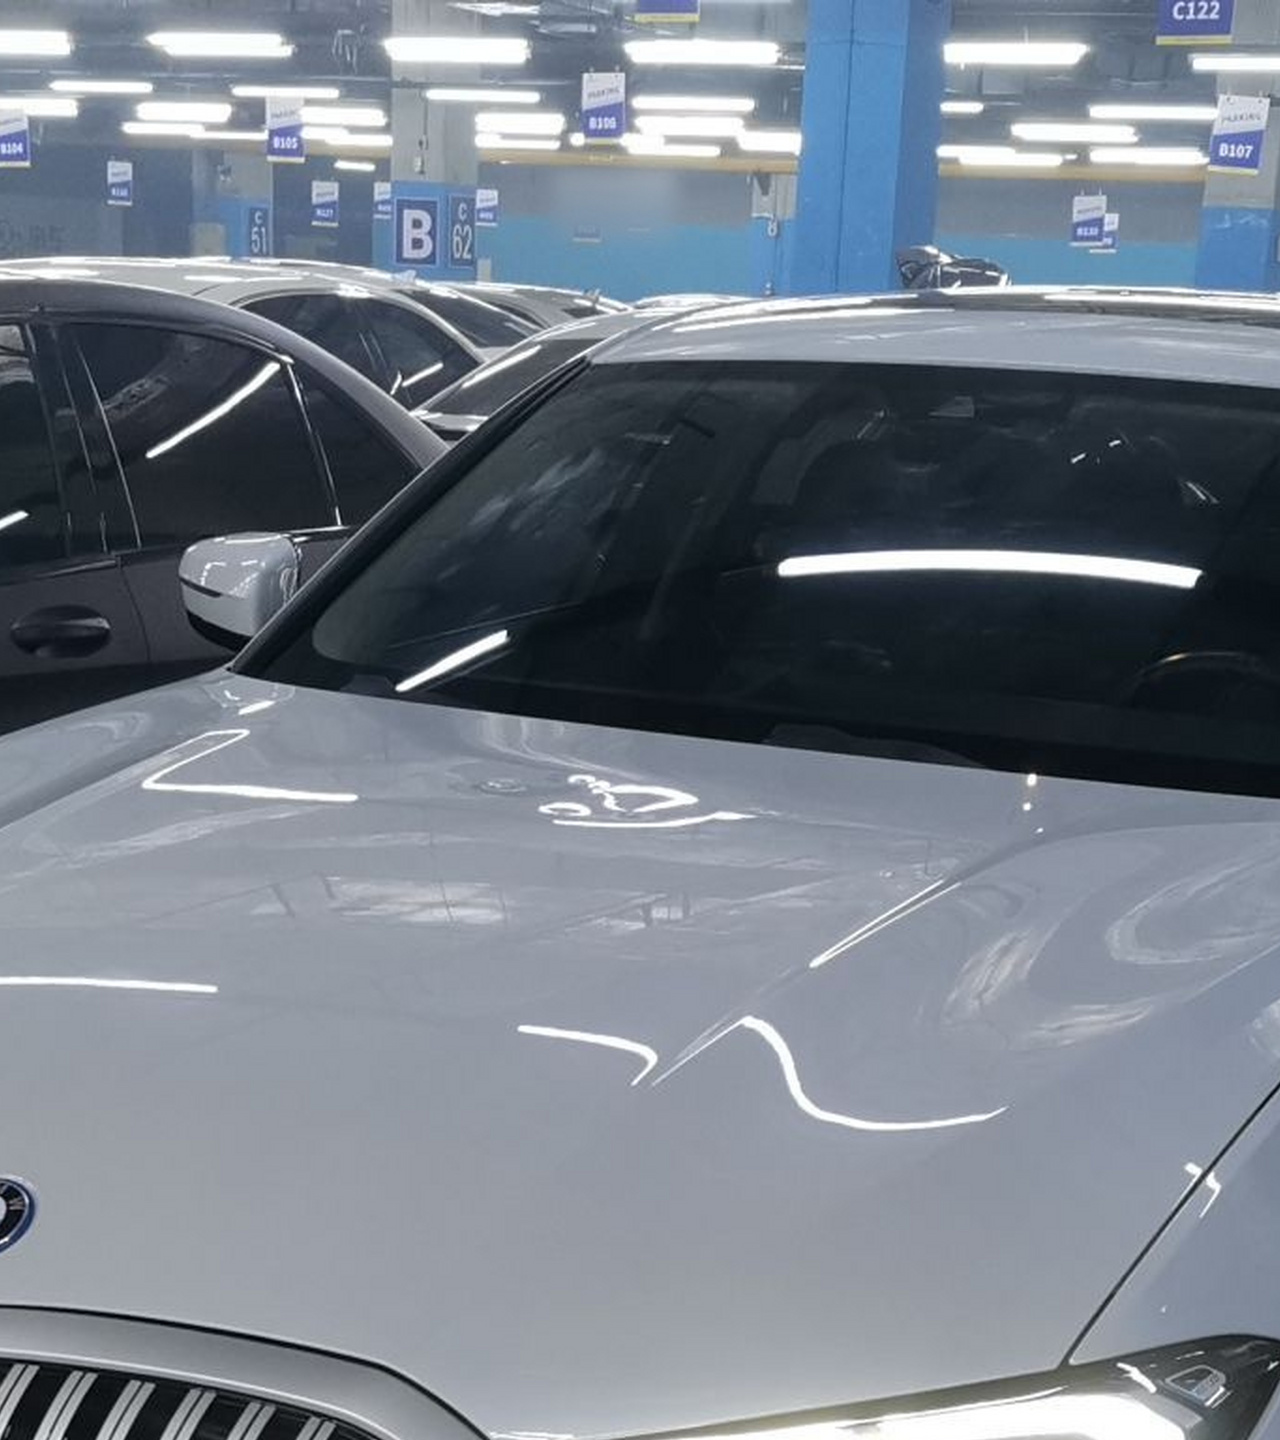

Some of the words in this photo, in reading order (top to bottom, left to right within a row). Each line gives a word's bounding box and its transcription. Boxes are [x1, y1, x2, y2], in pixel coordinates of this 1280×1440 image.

[1172, 2, 1220, 20] C122
[1220, 143, 1253, 158] B107
[458, 202, 468, 221] C
[403, 209, 433, 259] B
[453, 224, 472, 259] 62
